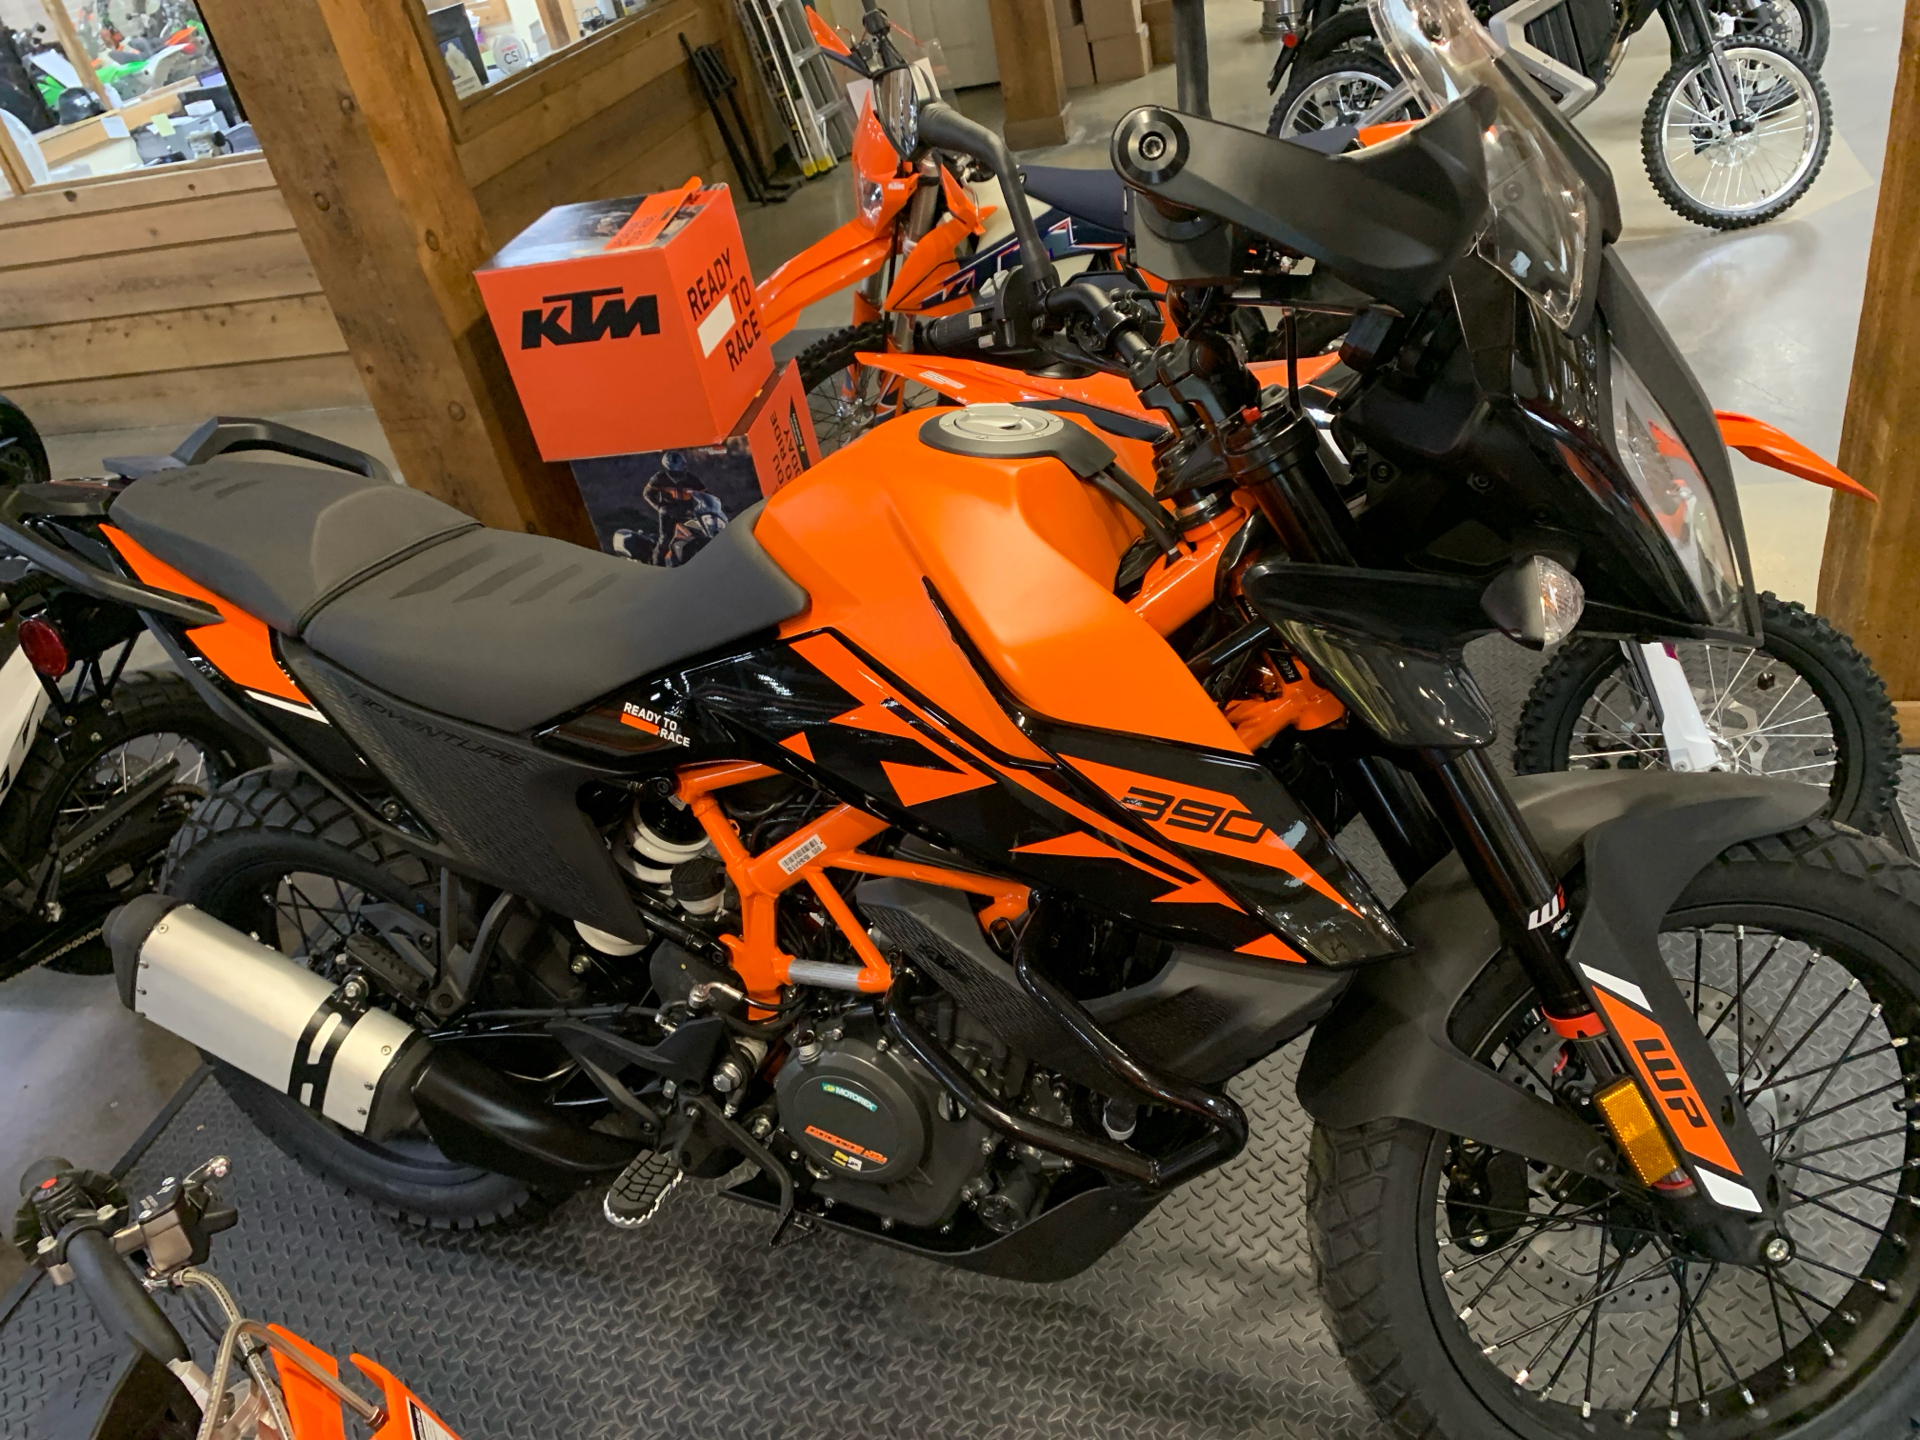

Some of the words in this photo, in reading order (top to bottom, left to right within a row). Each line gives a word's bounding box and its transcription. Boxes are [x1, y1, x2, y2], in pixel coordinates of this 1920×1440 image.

[686, 248, 735, 321] READY
[731, 275, 751, 315] TO
[521, 287, 660, 350] KTM
[725, 310, 762, 372] RACE
[769, 409, 787, 461] RIDE
[783, 428, 802, 478] ODAY
[623, 702, 661, 724] READY
[663, 717, 678, 731] TO
[660, 728, 690, 747] RACE
[1120, 786, 1267, 843] 390
[1552, 909, 1572, 933] APEX
[836, 1086, 877, 1112] MOTOREX
[1632, 1038, 1708, 1128] WP
